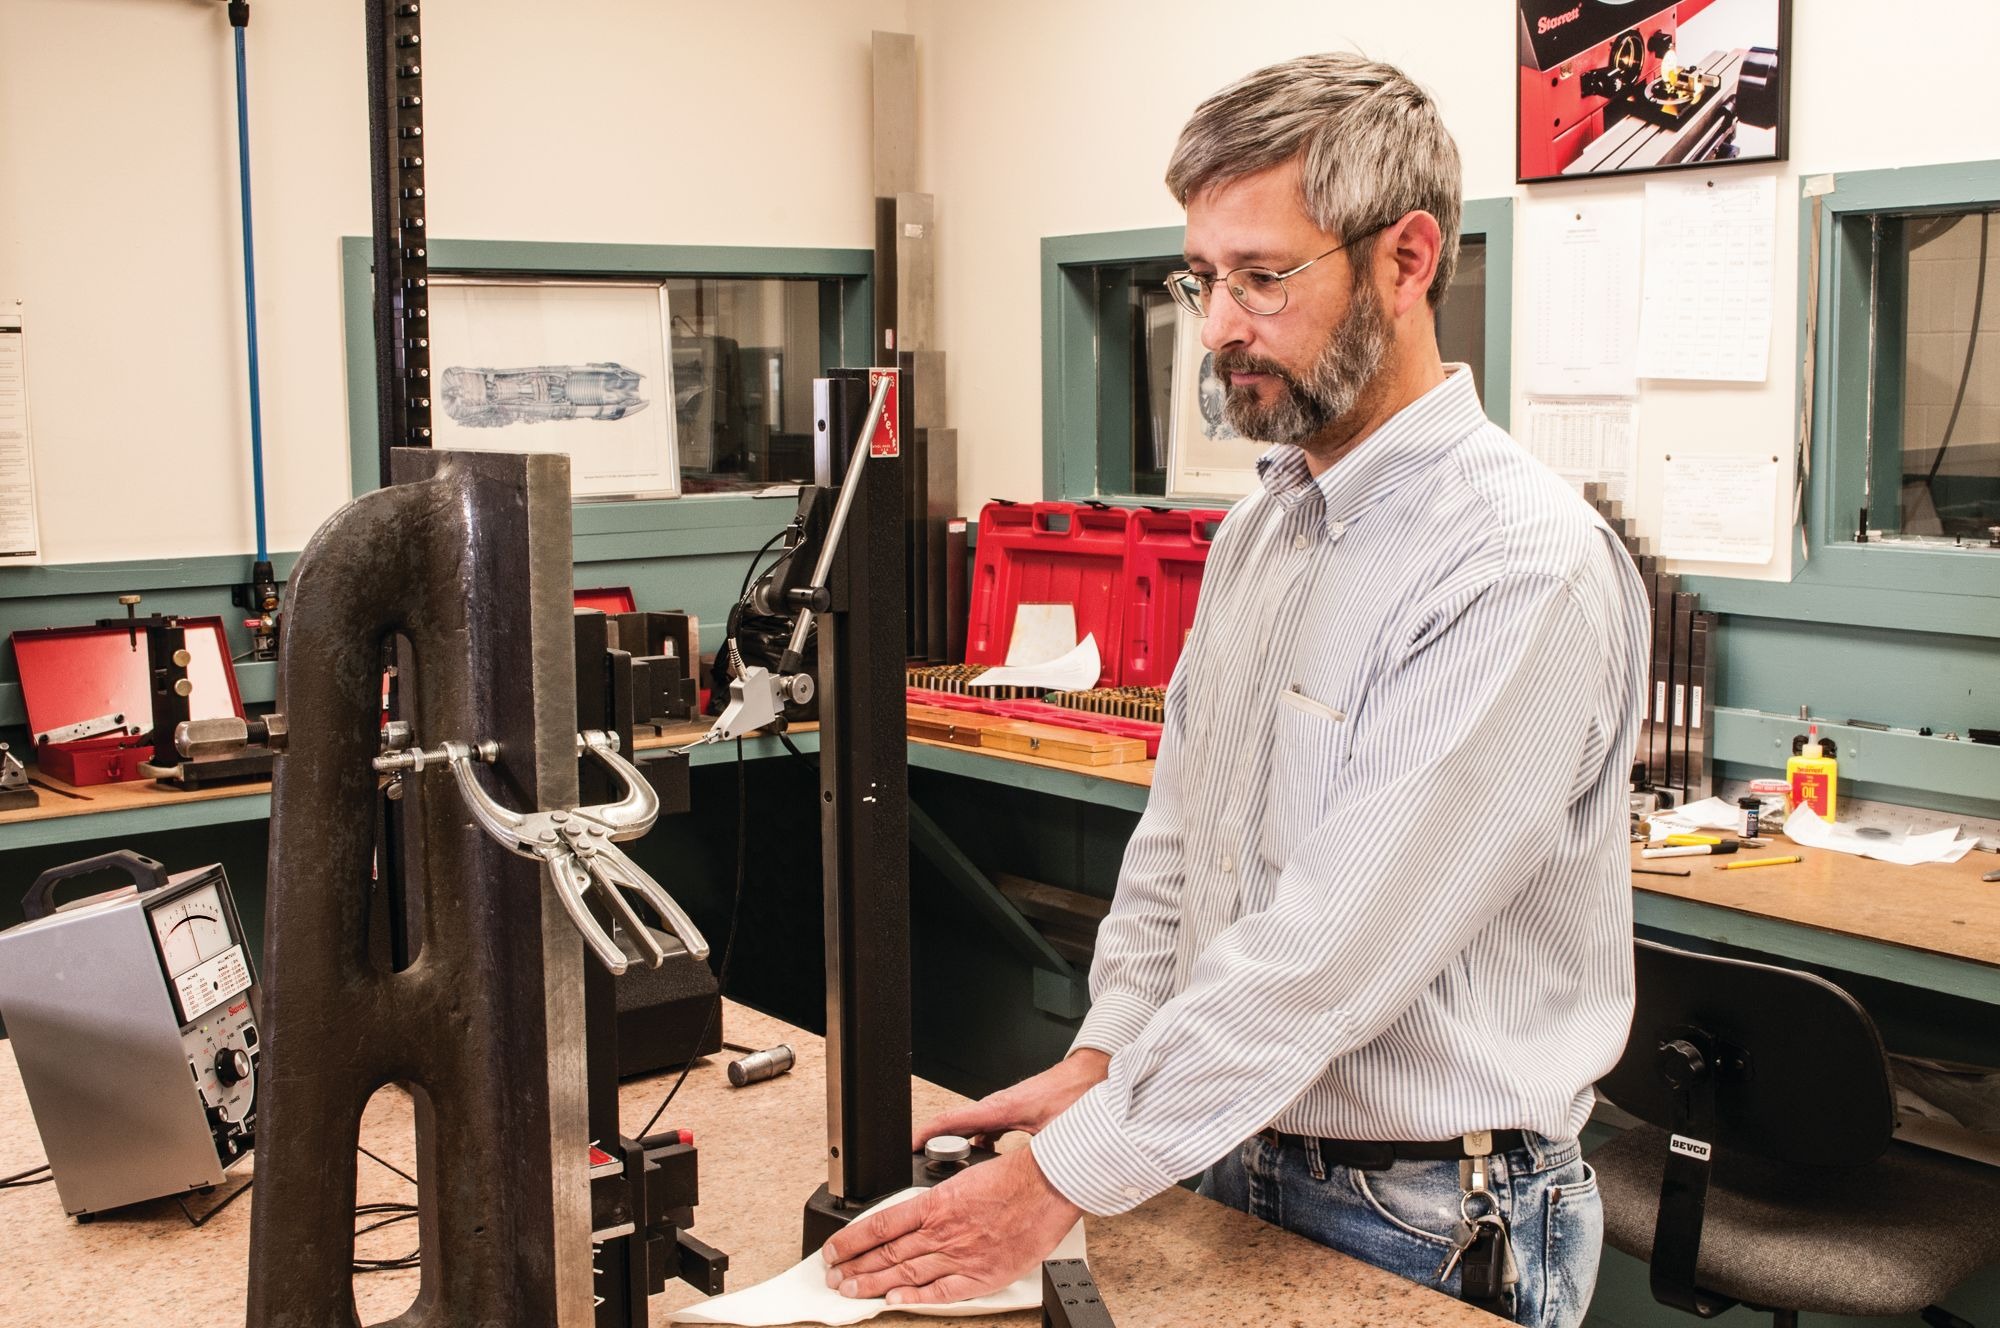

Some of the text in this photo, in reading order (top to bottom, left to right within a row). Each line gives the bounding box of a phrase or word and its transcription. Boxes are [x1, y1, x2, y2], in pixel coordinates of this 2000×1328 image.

[1537, 7, 1580, 34] Starrett
[1801, 785, 1818, 799] OIL
[1672, 1139, 1707, 1156] BEVCO
